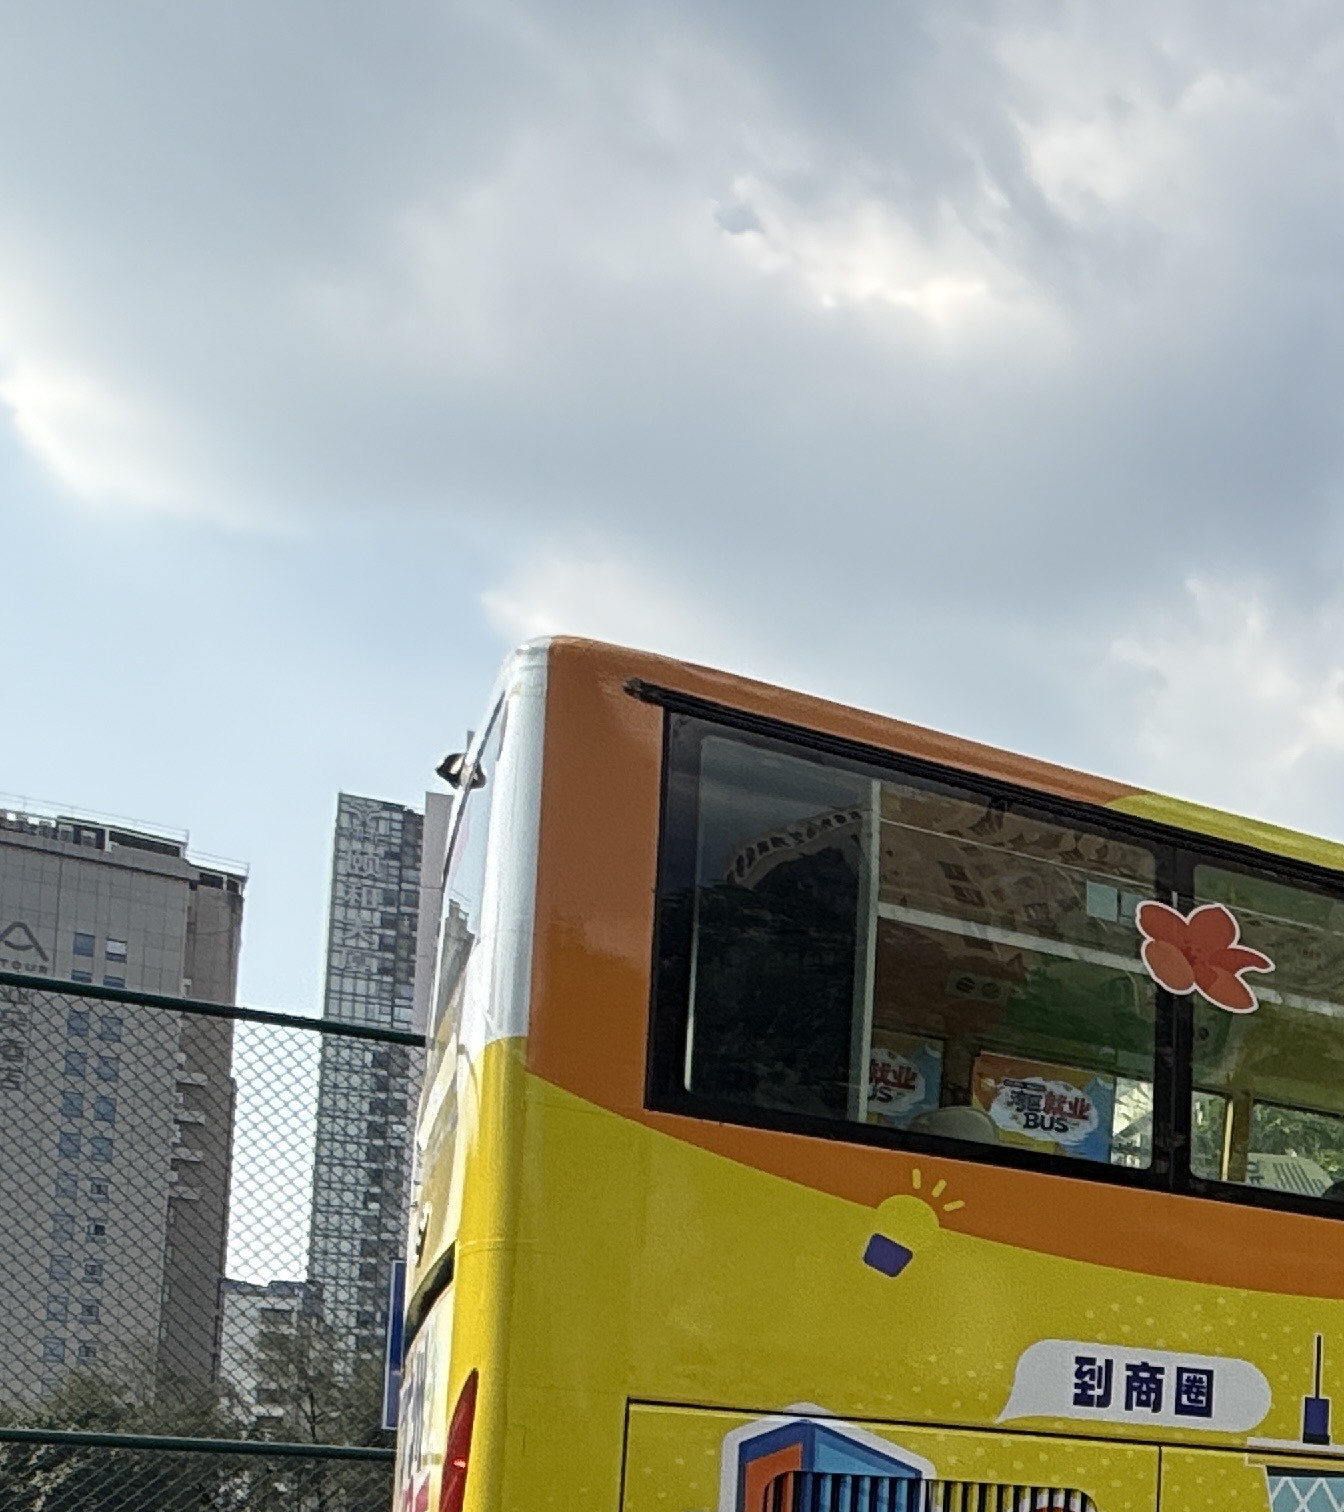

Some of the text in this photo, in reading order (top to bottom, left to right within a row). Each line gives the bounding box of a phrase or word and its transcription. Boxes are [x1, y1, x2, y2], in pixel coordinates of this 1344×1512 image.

[1023, 1112, 1069, 1133] BUS
[1073, 1356, 1214, 1418] 到商圈
